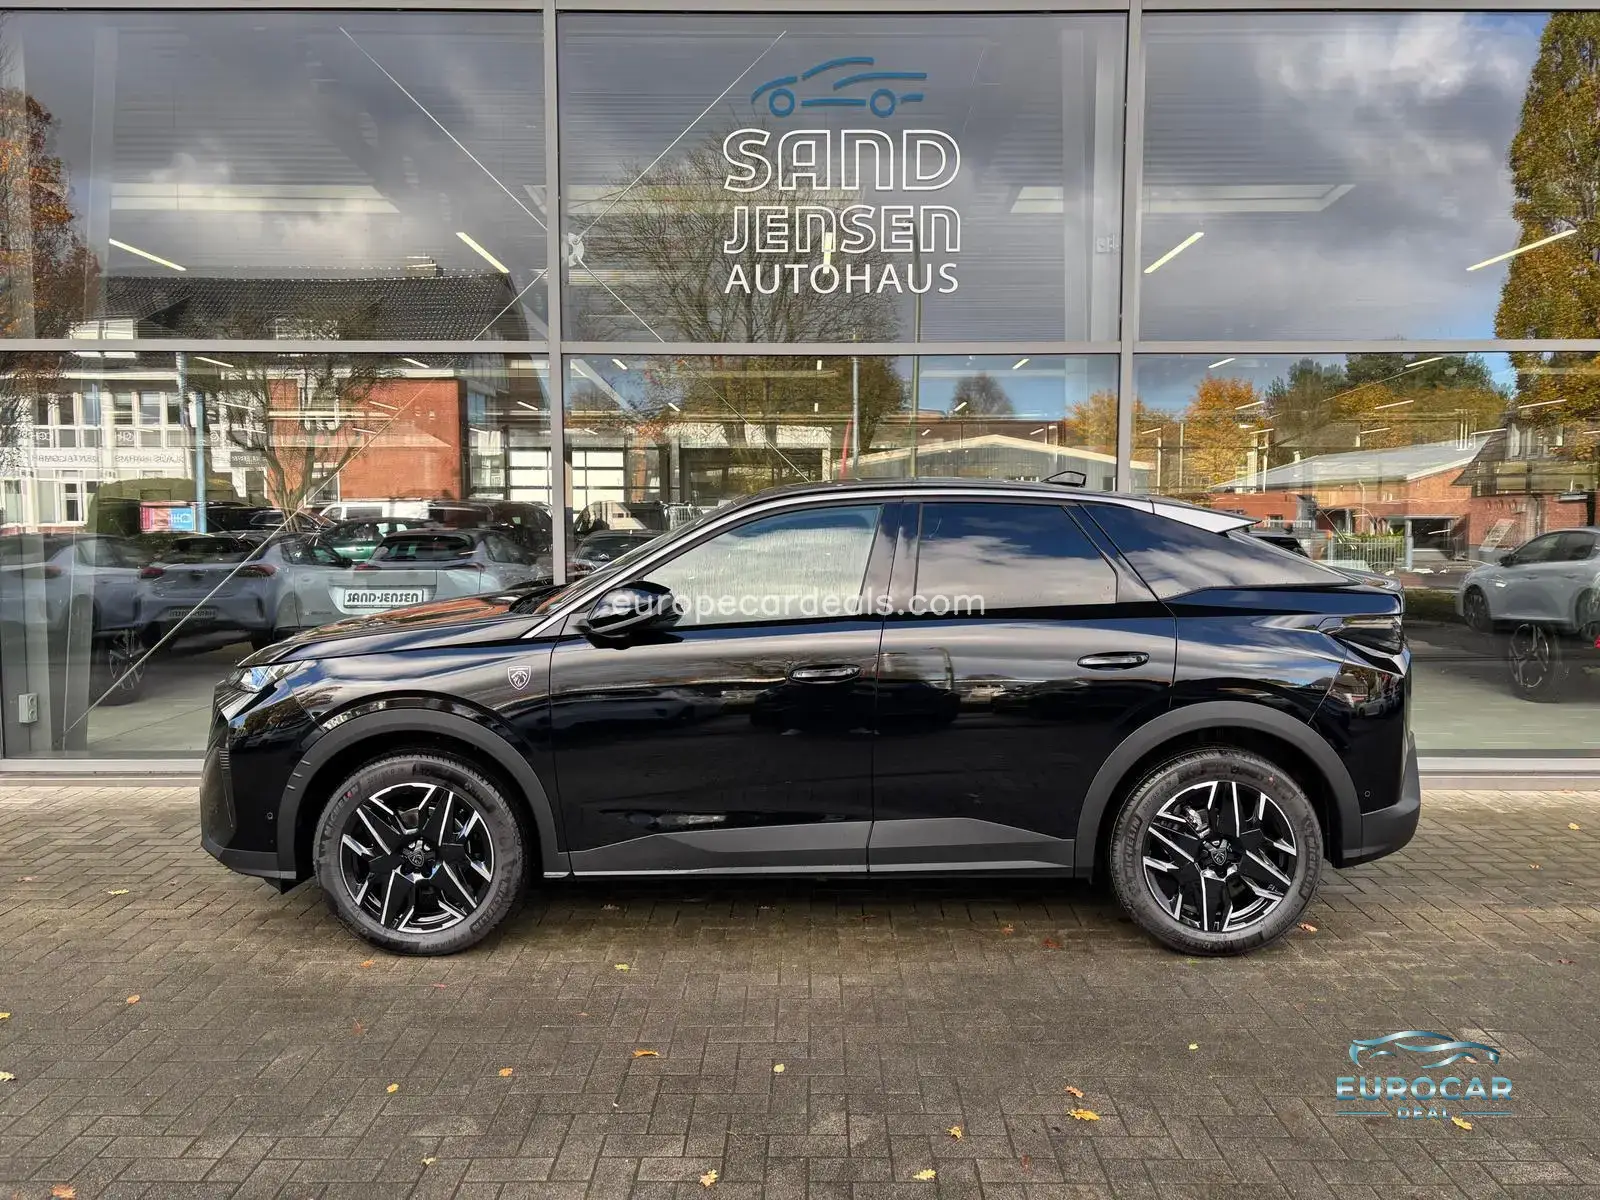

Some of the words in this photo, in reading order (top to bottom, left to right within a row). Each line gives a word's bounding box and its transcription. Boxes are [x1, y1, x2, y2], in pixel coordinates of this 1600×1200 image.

[723, 128, 961, 192] SAND
[724, 204, 961, 254] JENSEN
[724, 262, 959, 294] AUTOHAUS
[1125, 815, 1141, 878] MICHELIN
